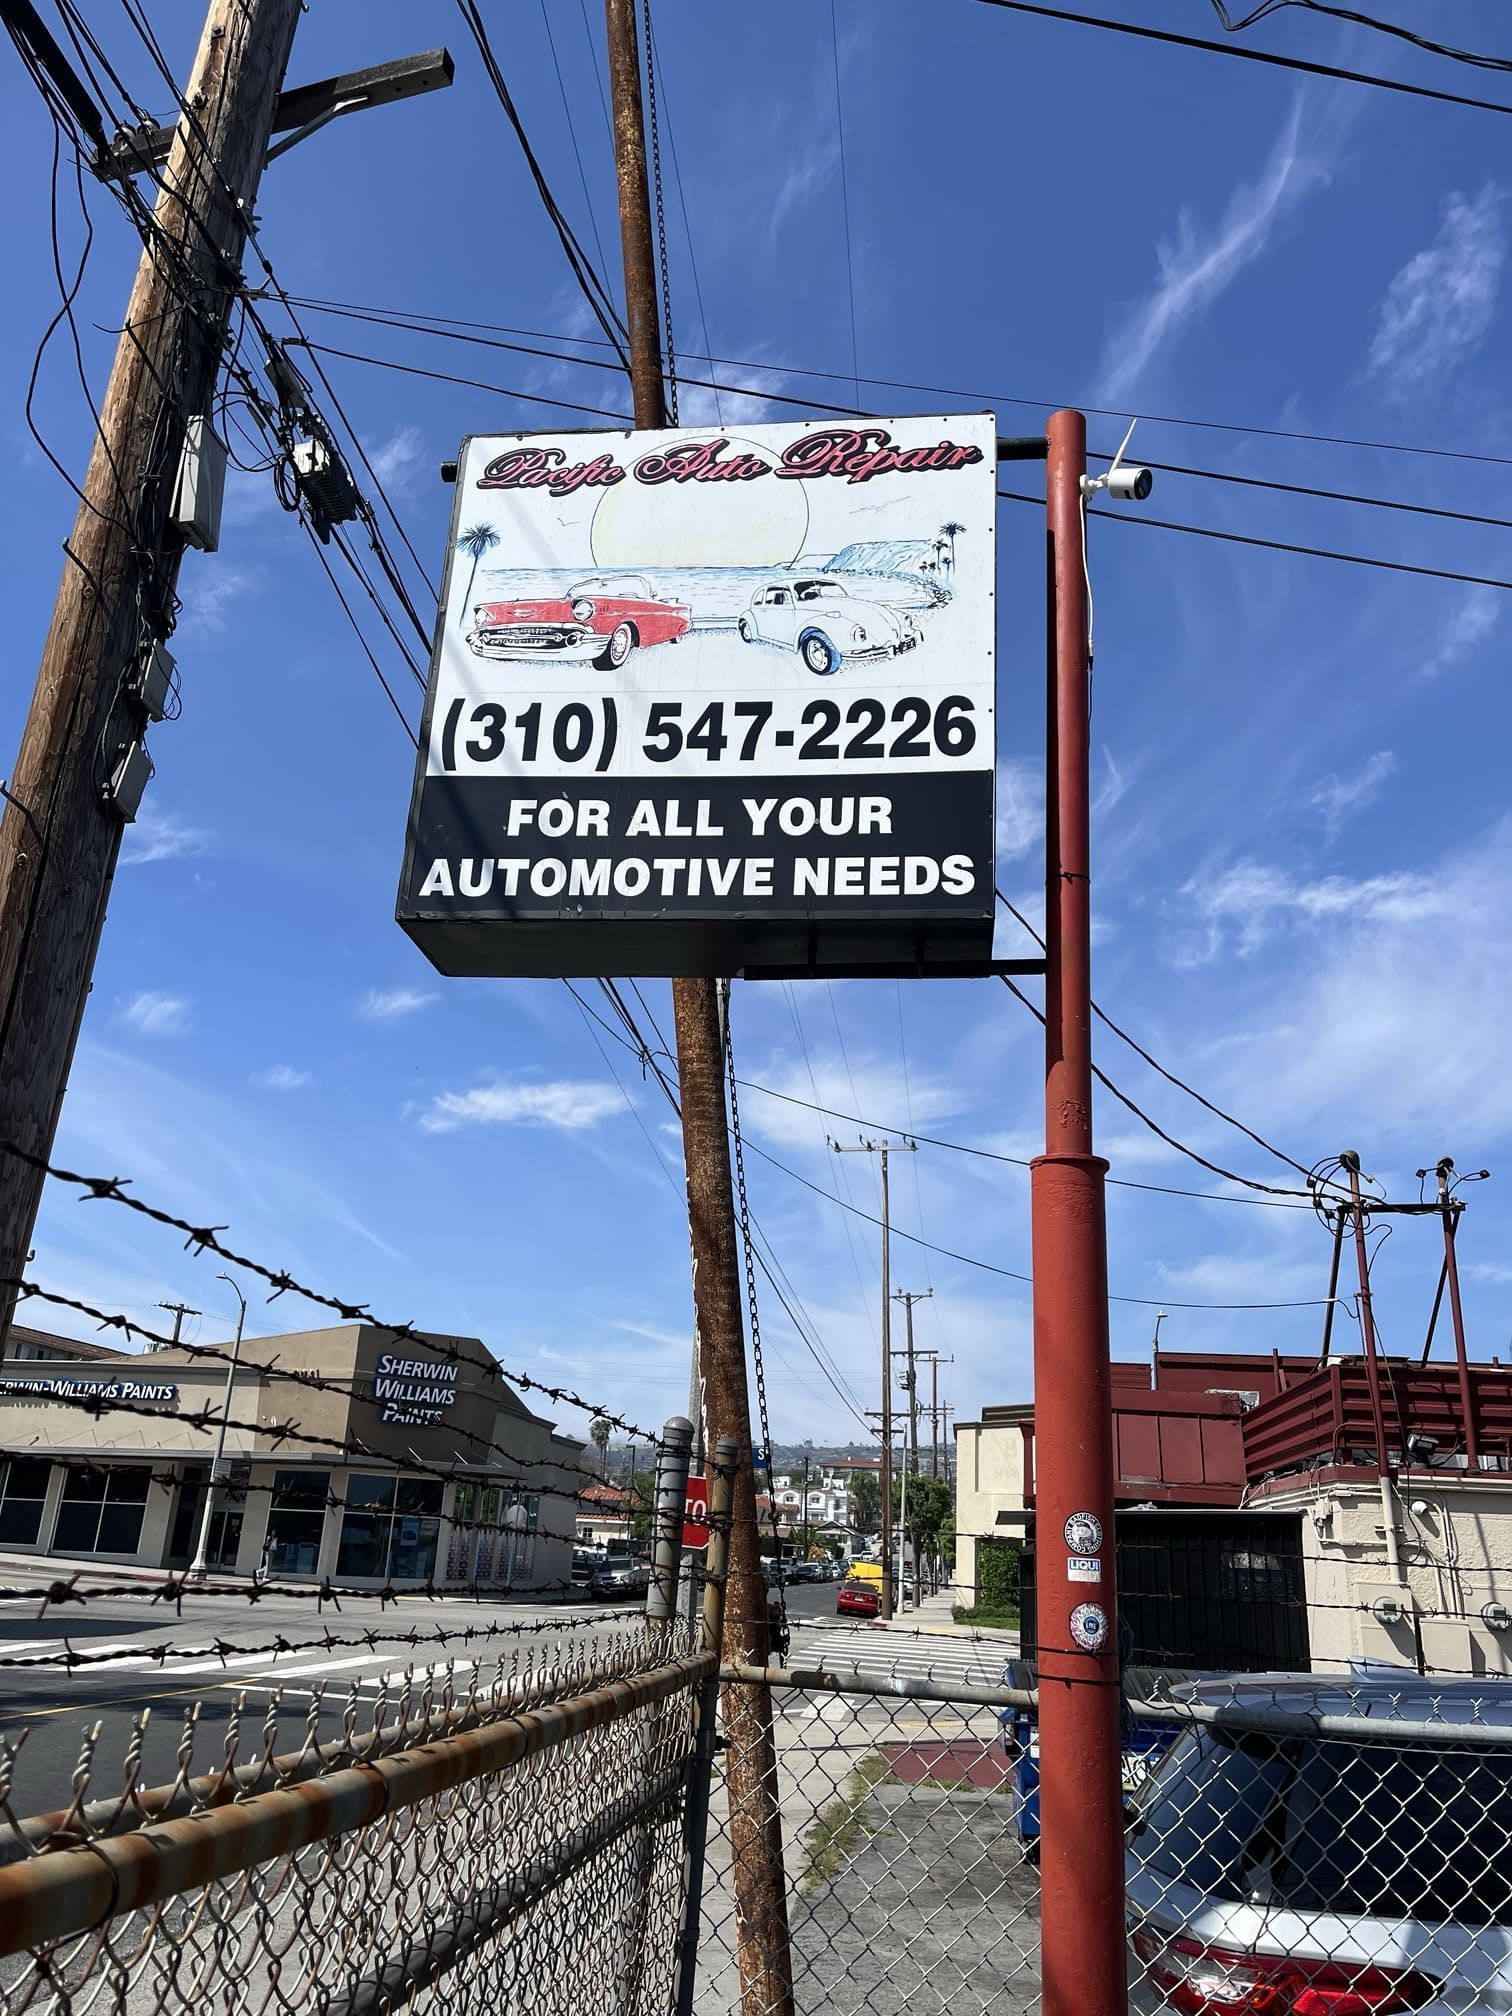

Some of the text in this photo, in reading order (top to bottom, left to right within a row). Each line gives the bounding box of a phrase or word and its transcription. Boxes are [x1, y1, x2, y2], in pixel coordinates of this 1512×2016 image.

[476, 429, 984, 497] Pacific Auto Repair
[442, 696, 976, 771] (310) 547-2226
[507, 797, 892, 837] FOR ALL YOUR
[419, 855, 976, 897] AUTOMOTIVE NEEDS
[378, 1354, 458, 1381] SHERWIN
[122, 1382, 173, 1400] PAINTS
[375, 1378, 456, 1405] WILLIAMS
[1070, 1559, 1099, 1571] LIQUI
